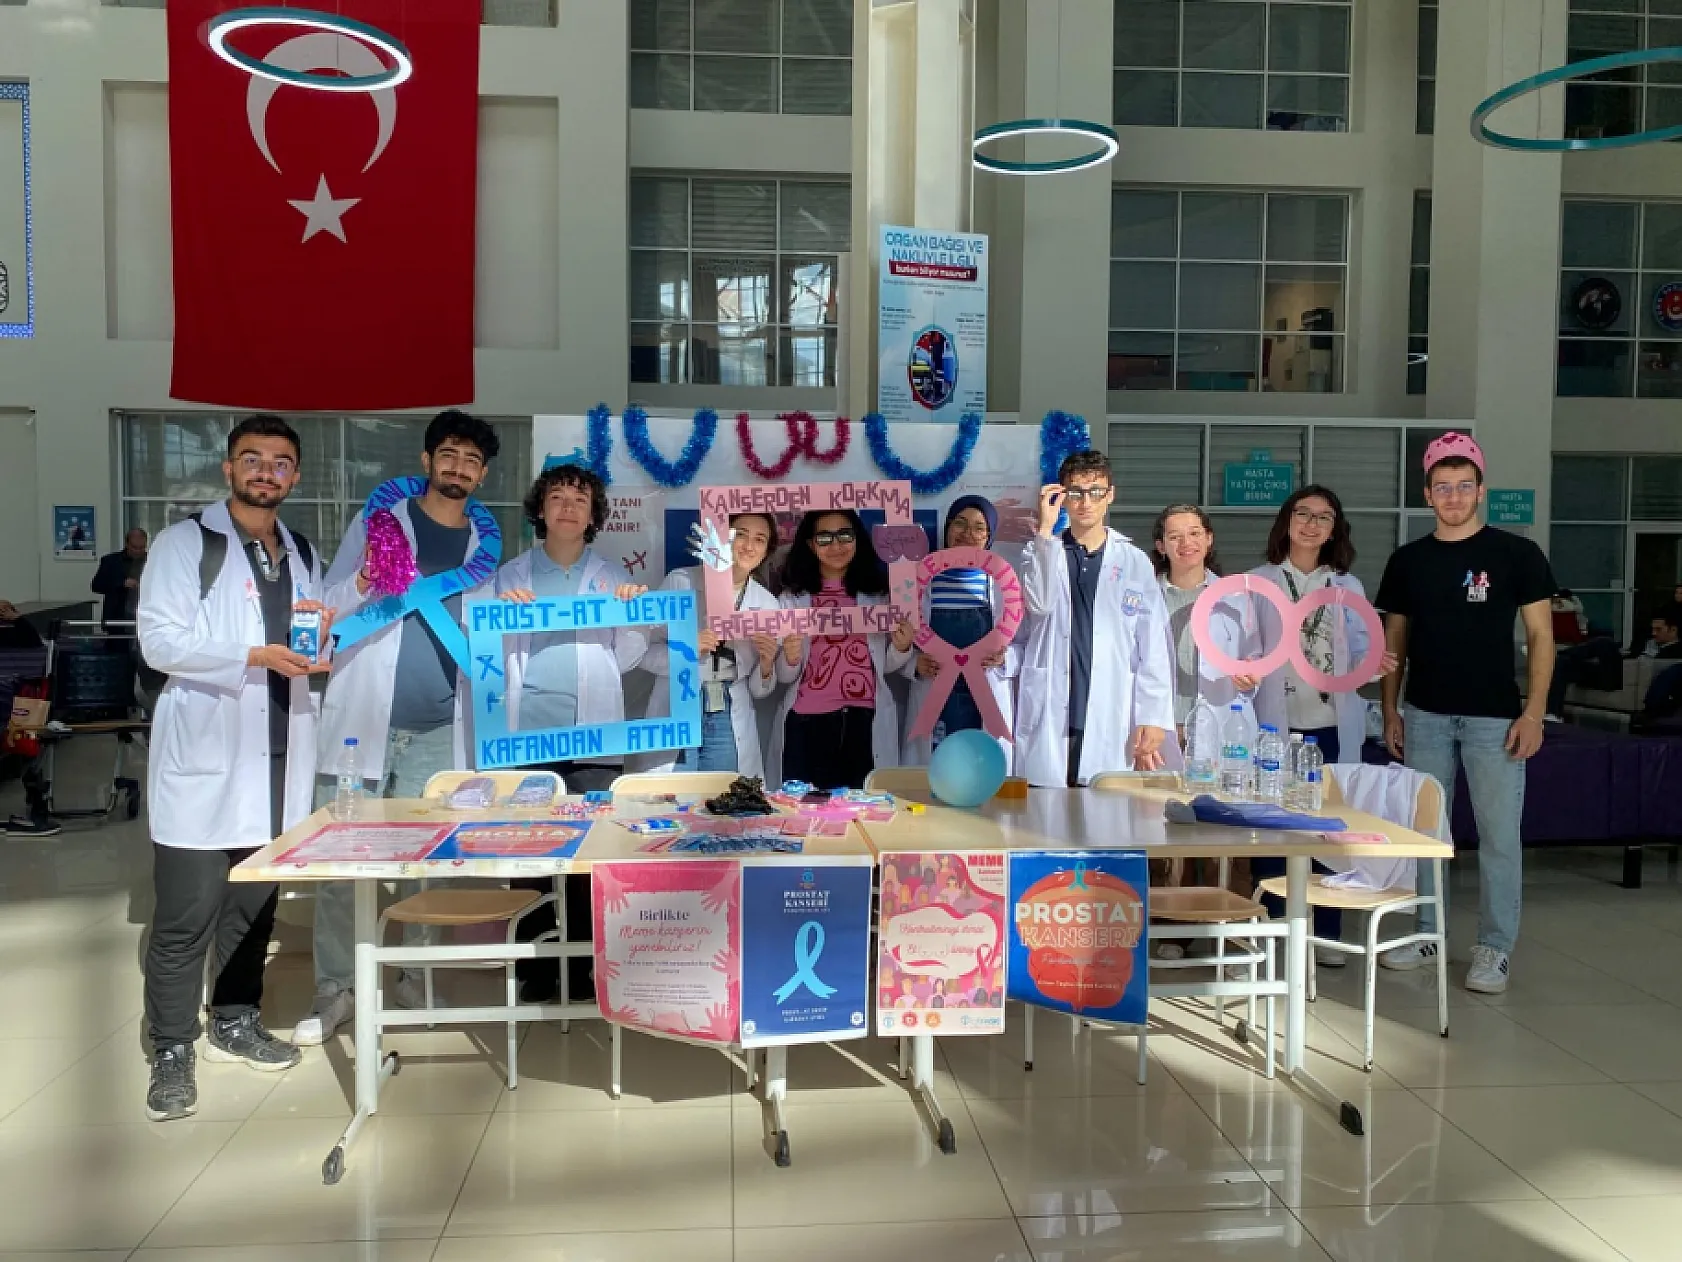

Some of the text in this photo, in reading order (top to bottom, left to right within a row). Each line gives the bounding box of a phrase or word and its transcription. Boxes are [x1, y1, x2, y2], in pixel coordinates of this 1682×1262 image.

[885, 232, 928, 248] ORGAN
[967, 240, 984, 254] VE
[612, 498, 641, 507] TANI
[700, 481, 910, 519] KANSERDEN KORKMA
[472, 599, 606, 631] PROST-AT
[709, 607, 853, 640] ERTELEMEKTEN
[481, 722, 691, 765] KAFANDAN ATMA
[640, 909, 690, 920] Birlikte
[1014, 902, 1144, 924] PROSTAT
